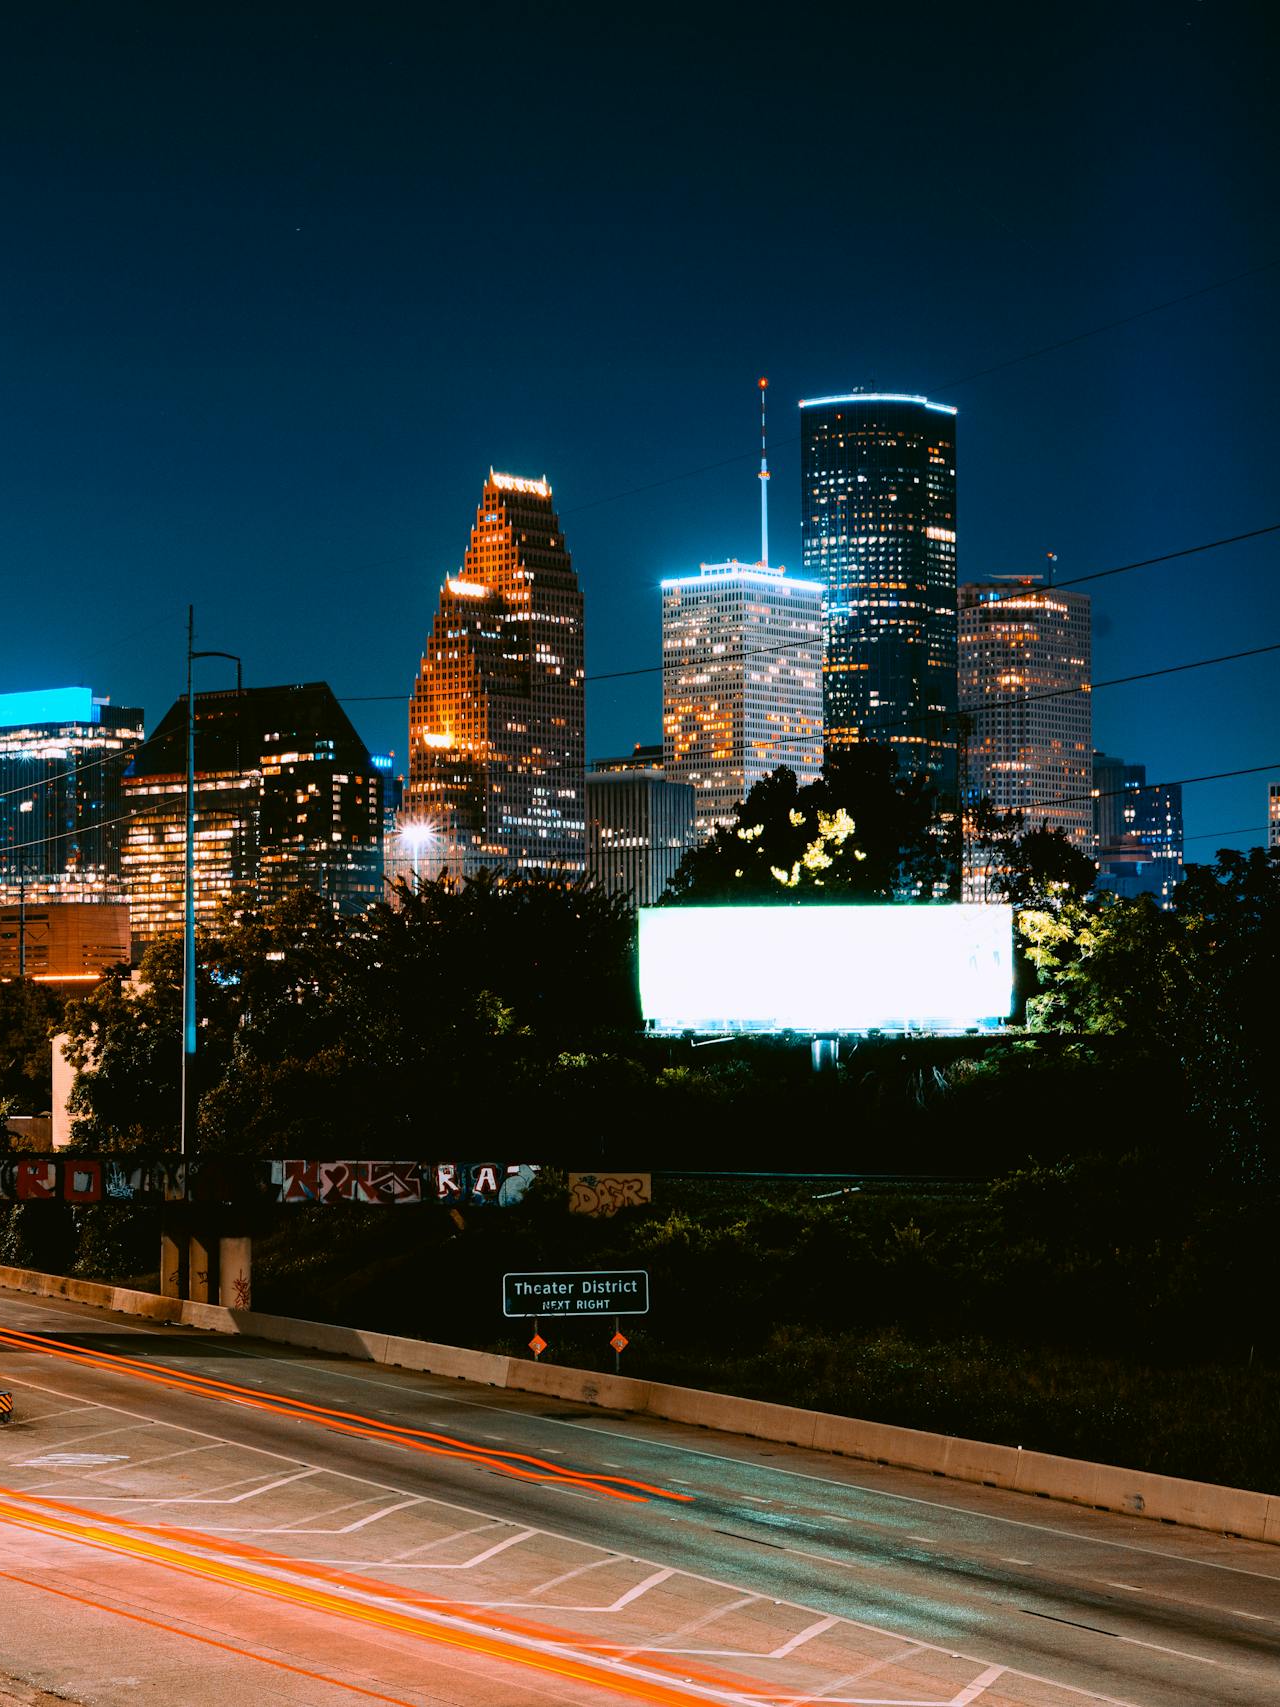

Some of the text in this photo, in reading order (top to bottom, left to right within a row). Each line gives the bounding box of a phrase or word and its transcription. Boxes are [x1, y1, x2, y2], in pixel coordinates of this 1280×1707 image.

[515, 1279, 638, 1295] Theater District
[543, 1299, 611, 1311] NEXT RIGHT
